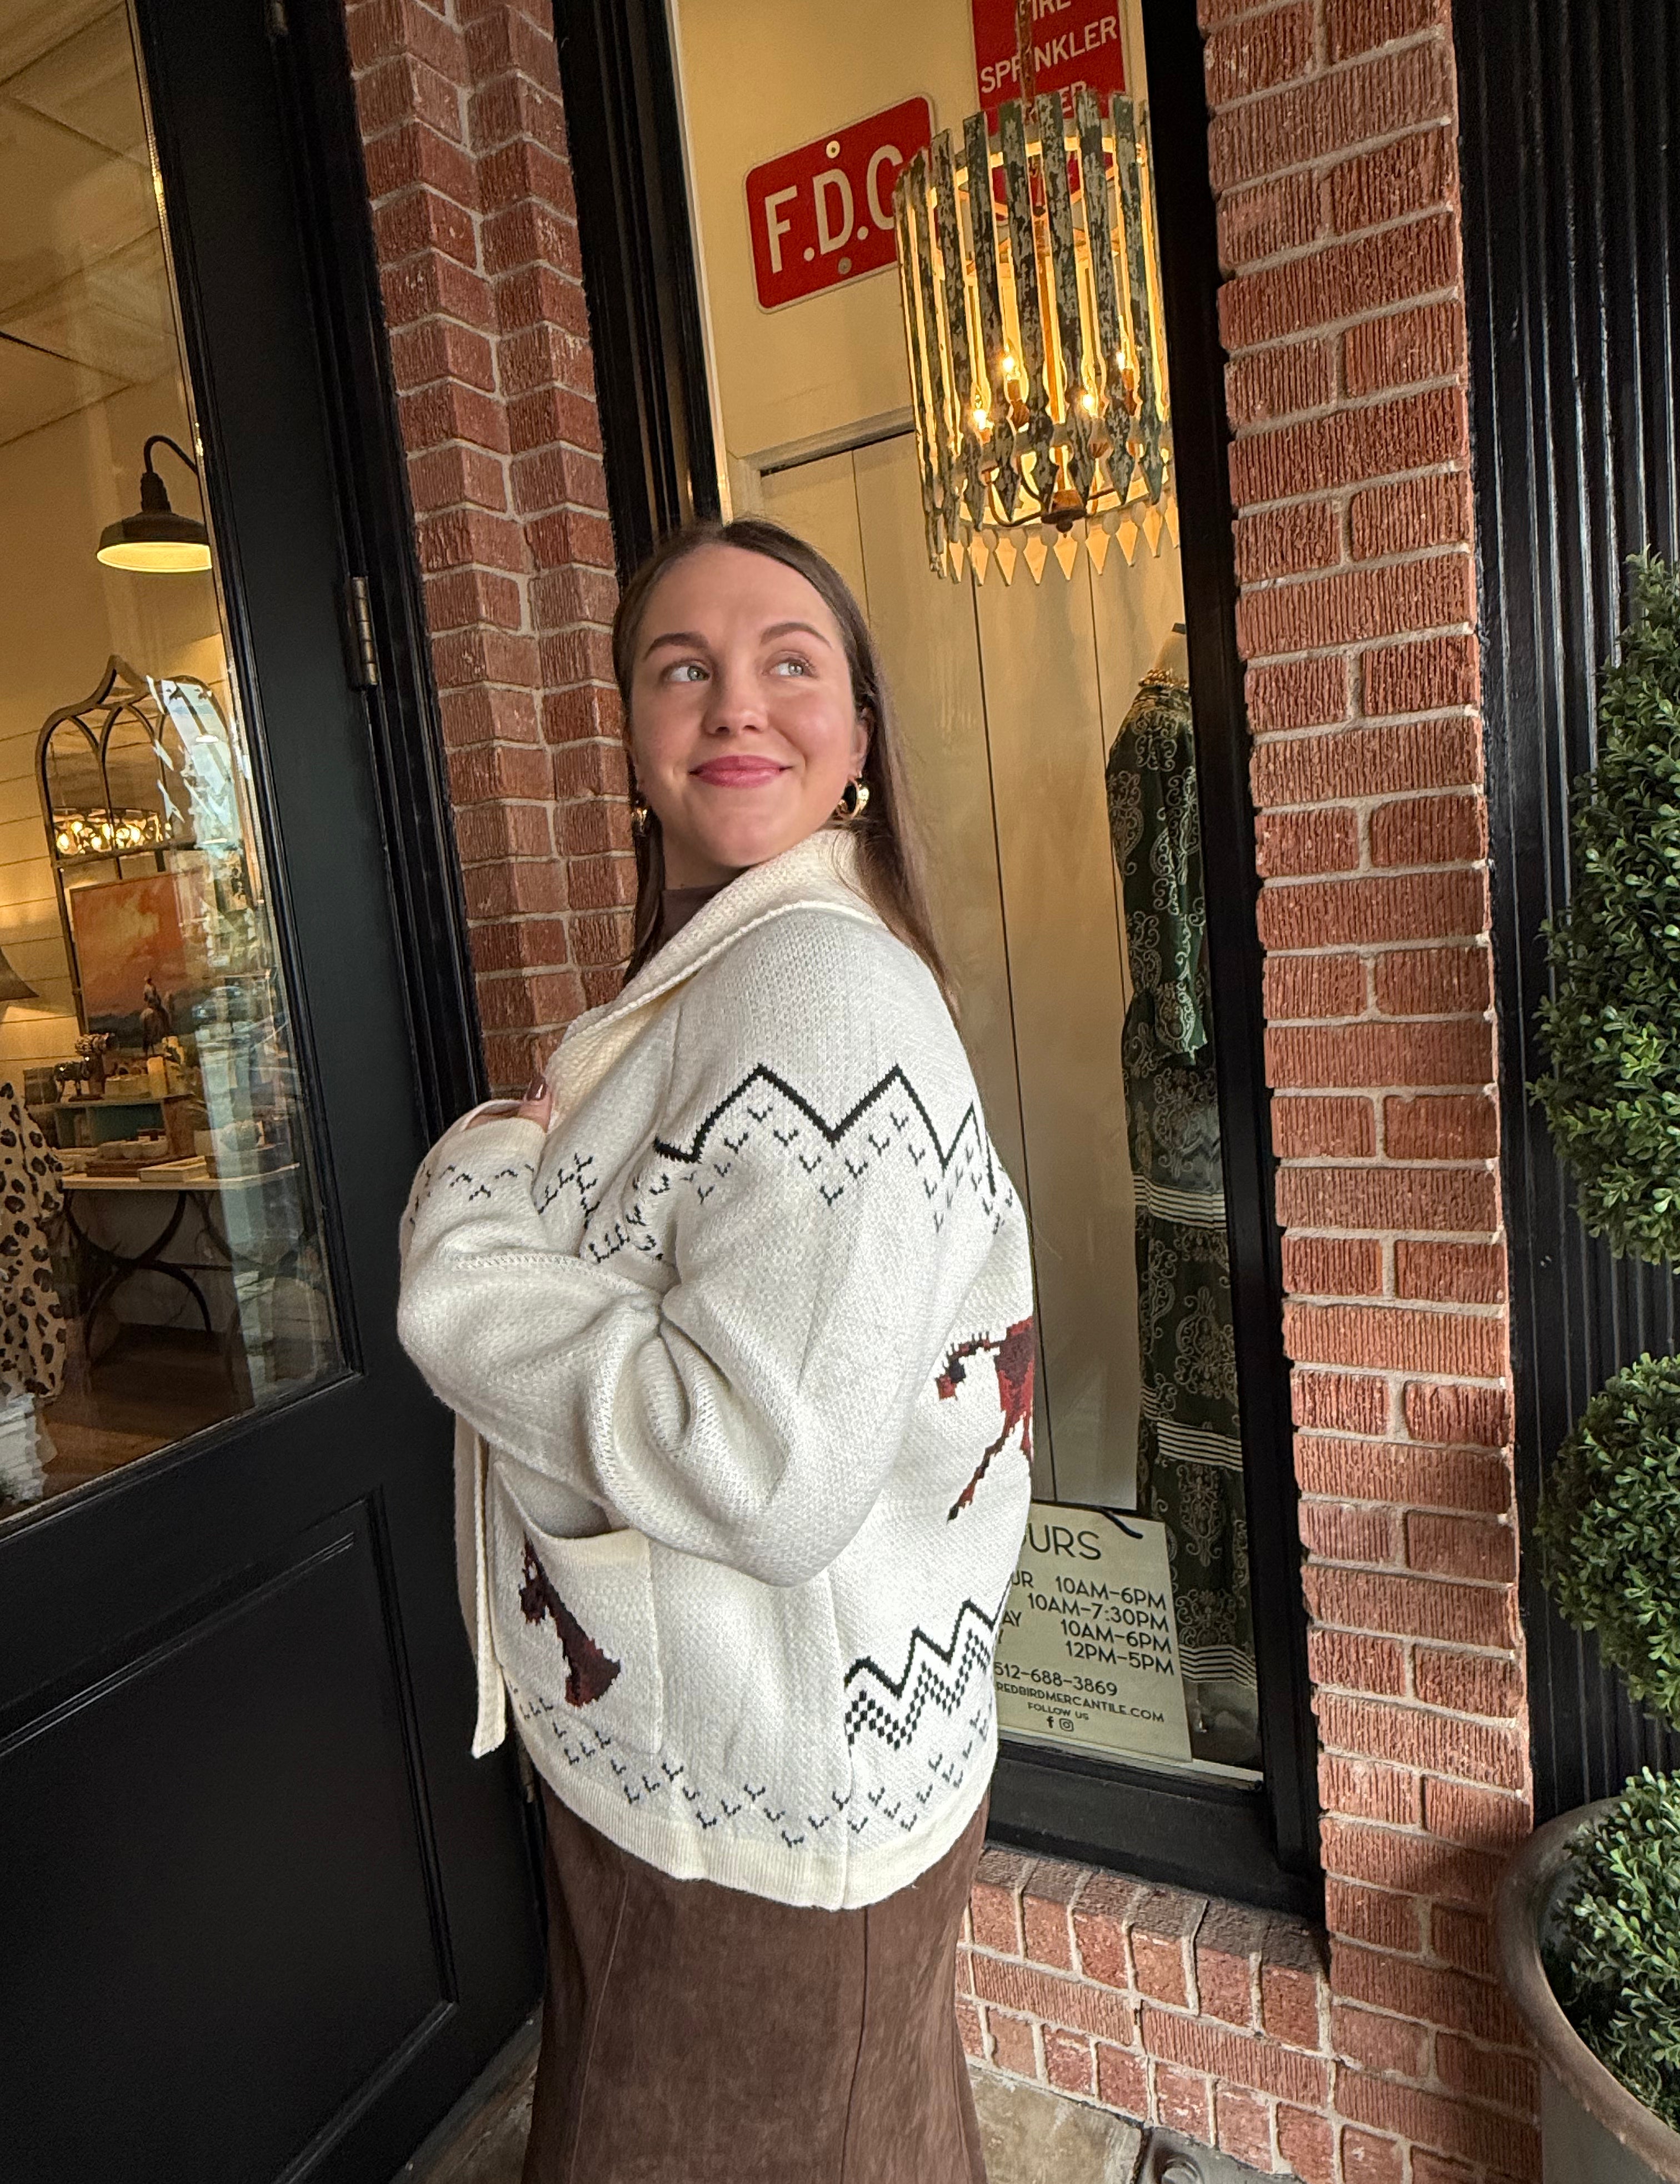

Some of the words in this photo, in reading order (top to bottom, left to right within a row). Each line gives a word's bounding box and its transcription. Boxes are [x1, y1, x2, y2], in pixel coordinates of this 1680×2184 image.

[980, 16, 1117, 93] SPRNKLER
[1023, 1522, 1101, 1560] URS
[1056, 1576, 1166, 1610] 10AM-6PM
[1028, 1592, 1169, 1632] 10AM-7:30PM
[1061, 1618, 1172, 1654] 10AM-6PM
[1066, 1640, 1174, 1675] 12PM-5PM
[993, 1661, 1117, 1696] 512-688-3869
[1027, 1701, 1071, 1716] FOLLOW
[1075, 1711, 1089, 1720] US
